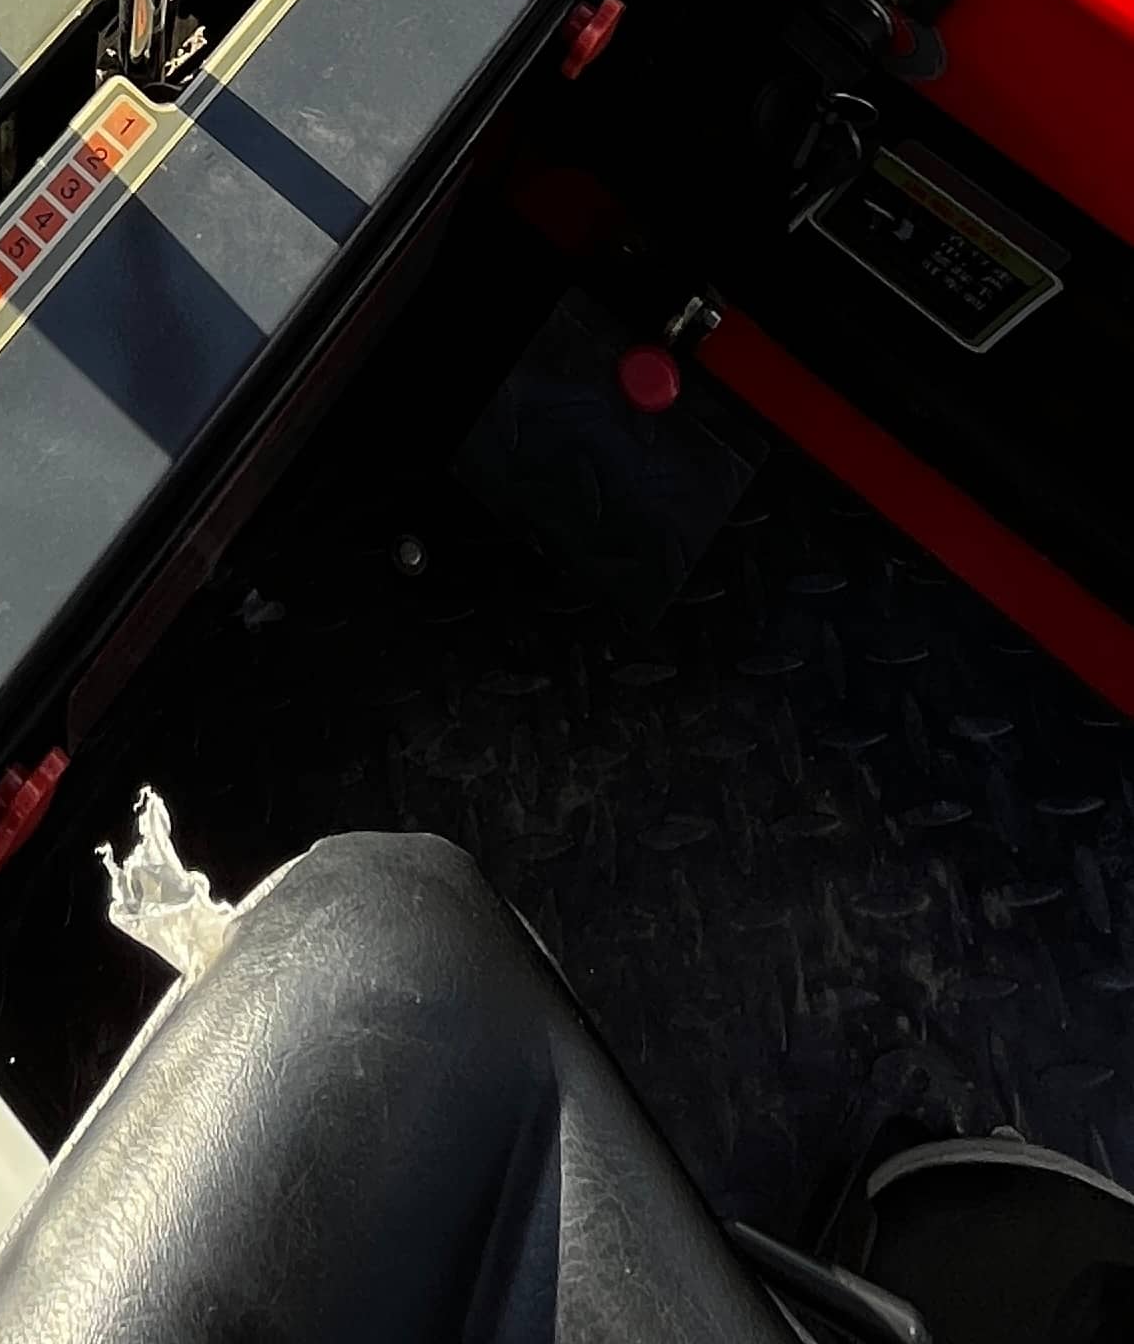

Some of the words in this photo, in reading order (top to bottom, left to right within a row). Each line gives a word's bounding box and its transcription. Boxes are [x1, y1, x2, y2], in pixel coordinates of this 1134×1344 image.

[120, 117, 135, 136] 1
[87, 147, 108, 170] 2
[60, 178, 81, 200] 3
[35, 211, 54, 231] 4
[8, 236, 30, 259] 5
